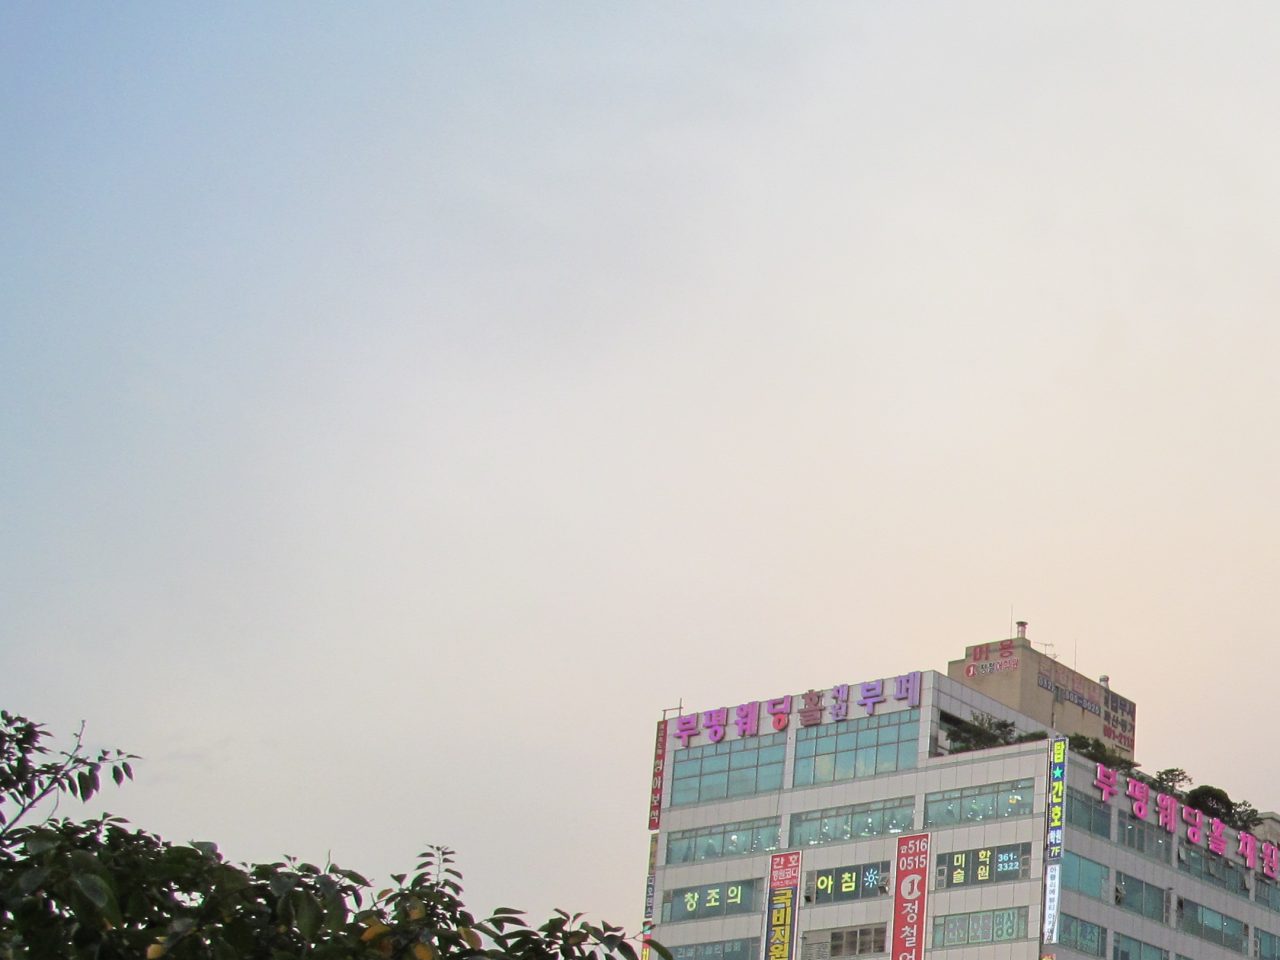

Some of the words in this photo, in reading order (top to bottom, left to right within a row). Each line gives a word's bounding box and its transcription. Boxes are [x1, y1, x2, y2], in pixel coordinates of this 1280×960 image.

[858, 671, 921, 715] 부페
[908, 838, 928, 852] 516
[1050, 846, 1061, 858] 7F
[900, 854, 927, 870] 0515
[998, 862, 1020, 871] 3322
[684, 885, 742, 911] 창조의
[817, 871, 857, 894] 아침
